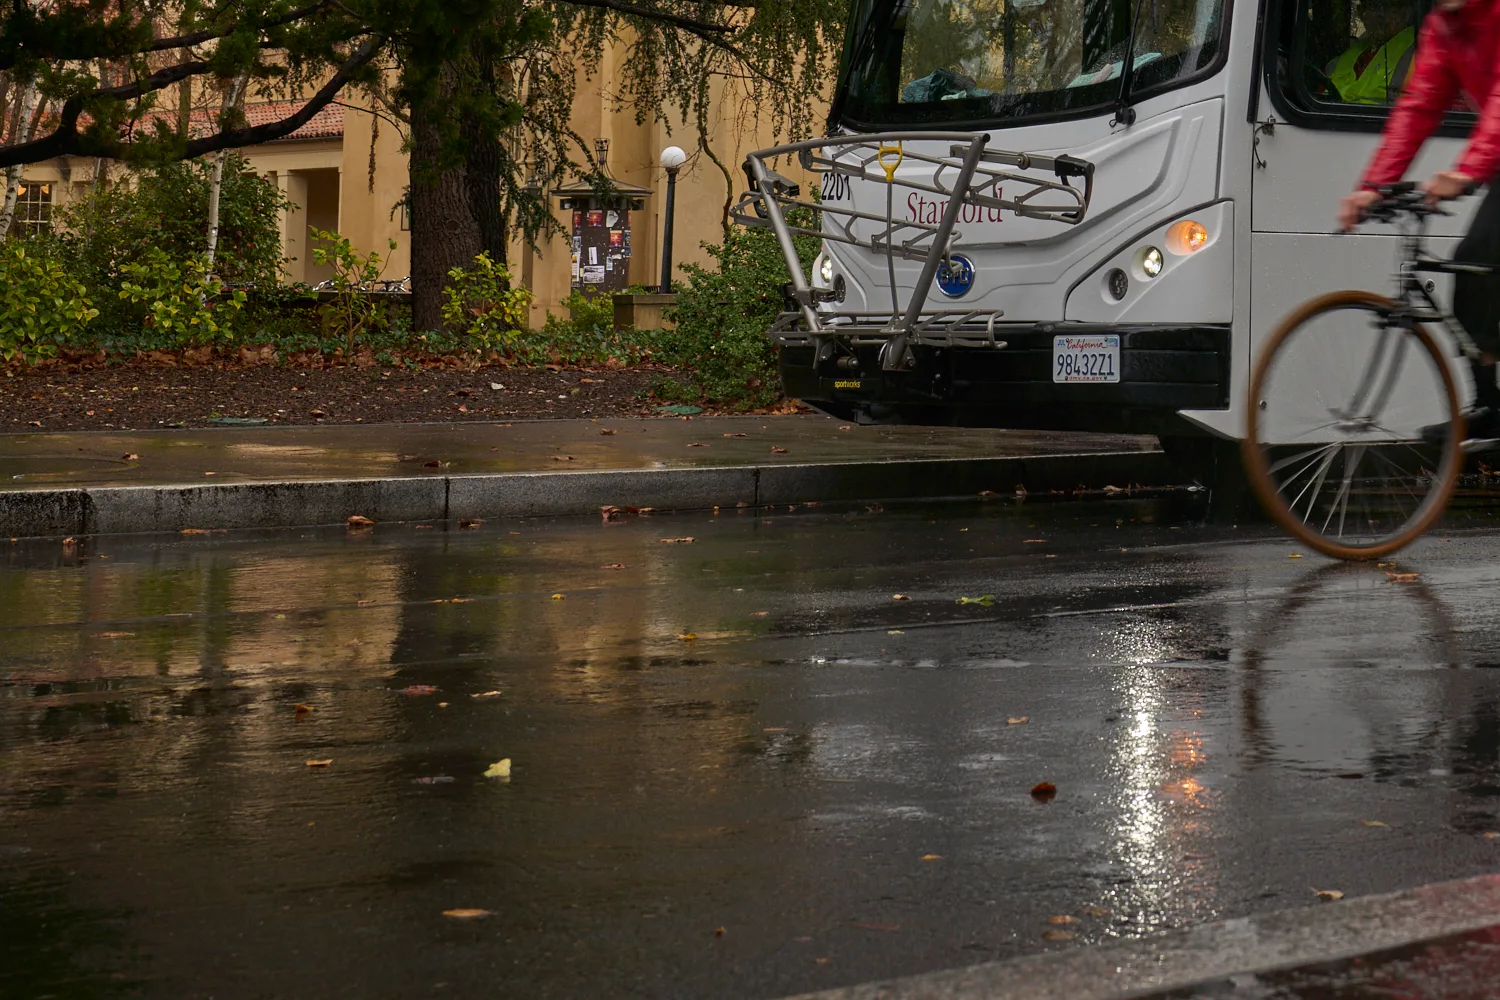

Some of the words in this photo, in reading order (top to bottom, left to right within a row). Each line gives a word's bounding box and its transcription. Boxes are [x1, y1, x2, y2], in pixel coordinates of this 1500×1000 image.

[822, 172, 851, 201] 2201
[1066, 339, 1107, 352] California
[1057, 353, 1114, 376] 98432Z1
